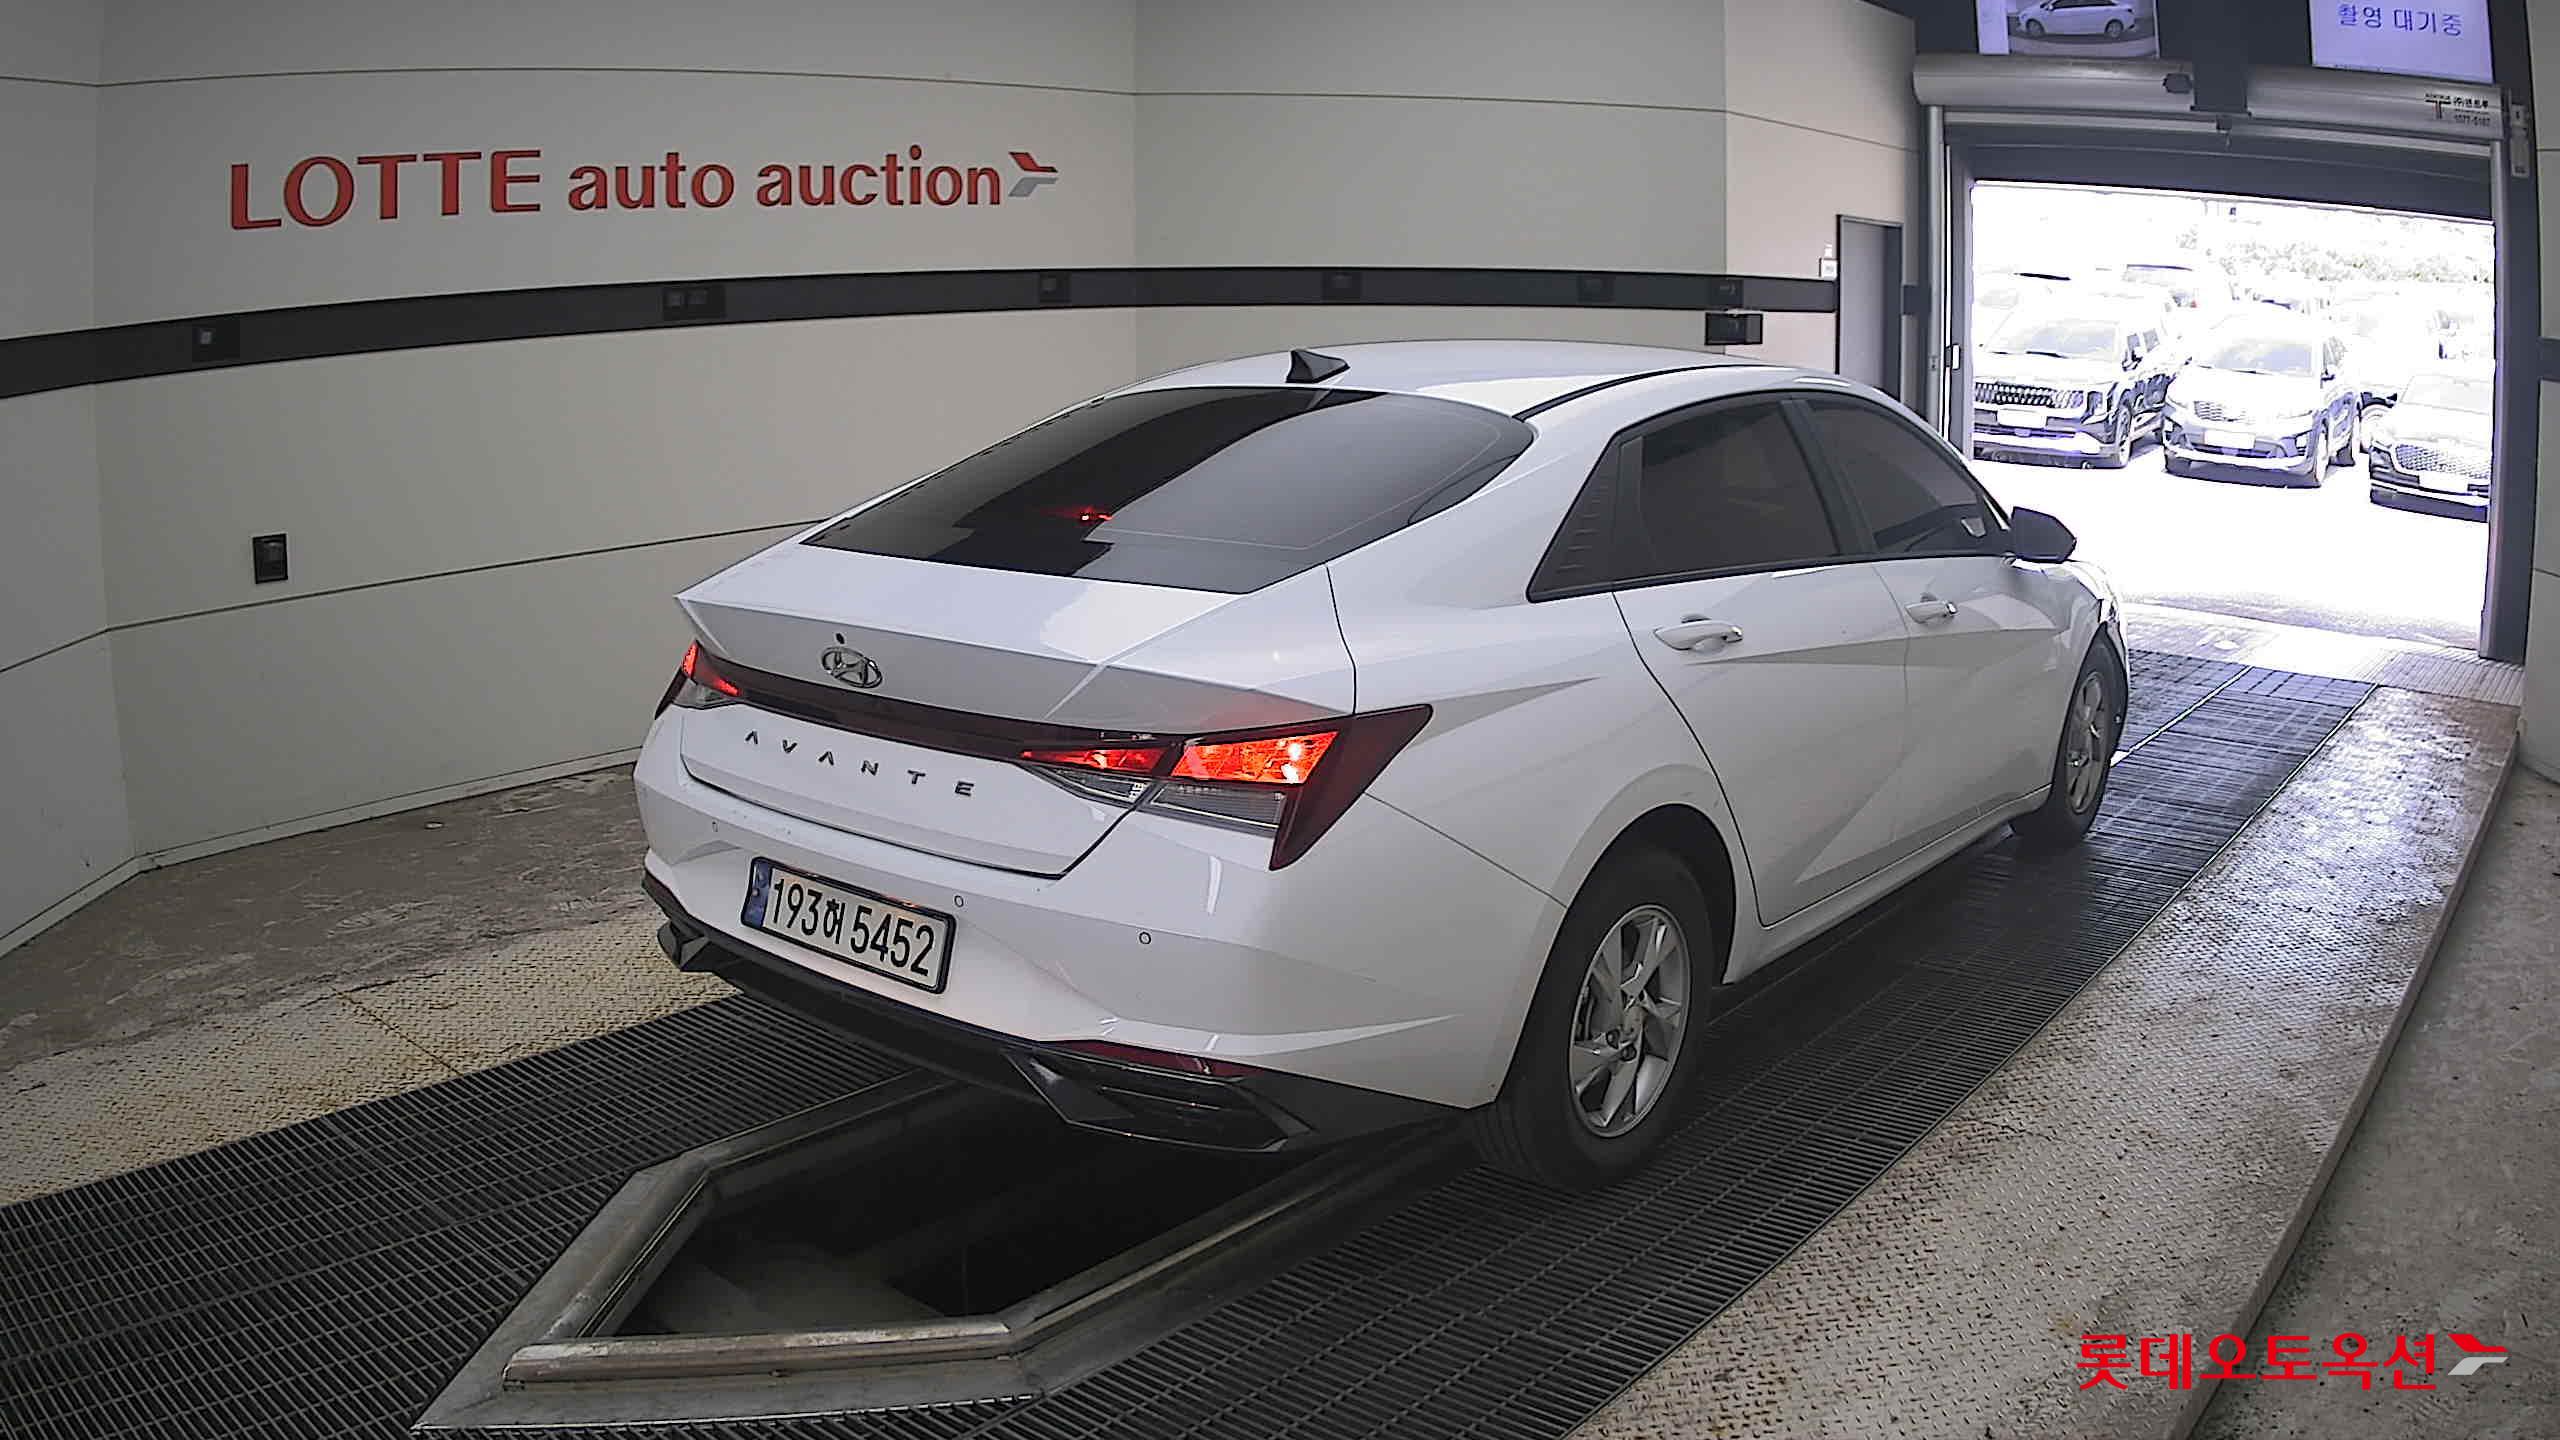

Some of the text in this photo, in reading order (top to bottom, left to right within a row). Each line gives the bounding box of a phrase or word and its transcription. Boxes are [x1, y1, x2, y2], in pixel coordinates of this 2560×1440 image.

[2337, 3, 2463, 37] 촬영 대기중
[230, 145, 1003, 230] LOTTE auto auction
[745, 730, 975, 797] AVANTE
[772, 877, 935, 977] 193허 5452
